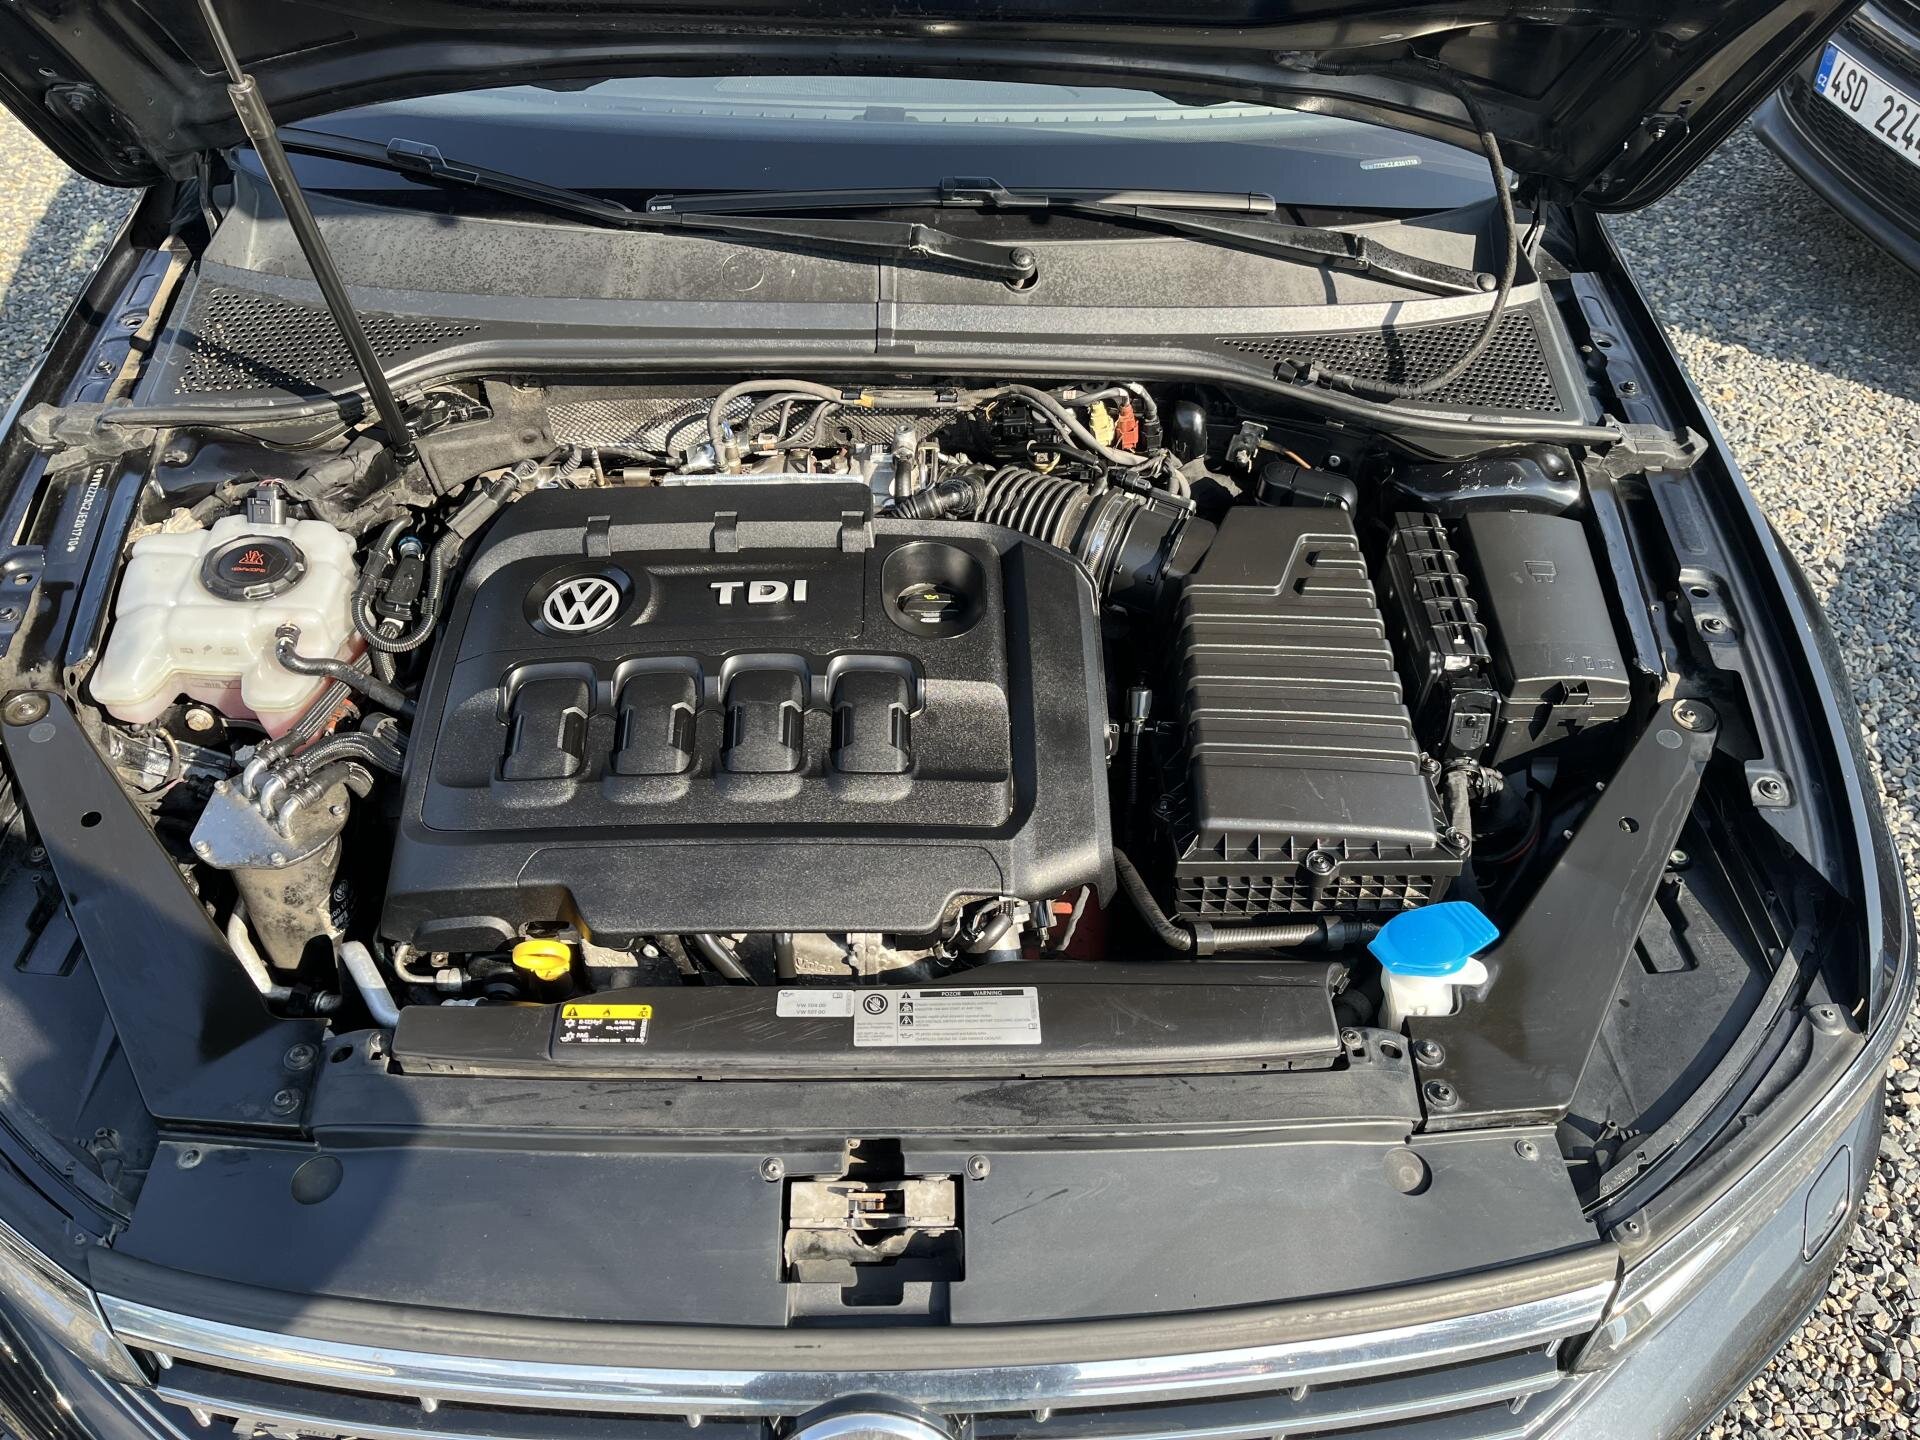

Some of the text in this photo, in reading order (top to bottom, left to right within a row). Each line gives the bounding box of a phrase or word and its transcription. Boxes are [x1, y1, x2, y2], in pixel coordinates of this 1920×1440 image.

[1816, 73, 1828, 88] CZ
[1831, 61, 1920, 160] 4SD 224
[710, 579, 808, 605] TDI
